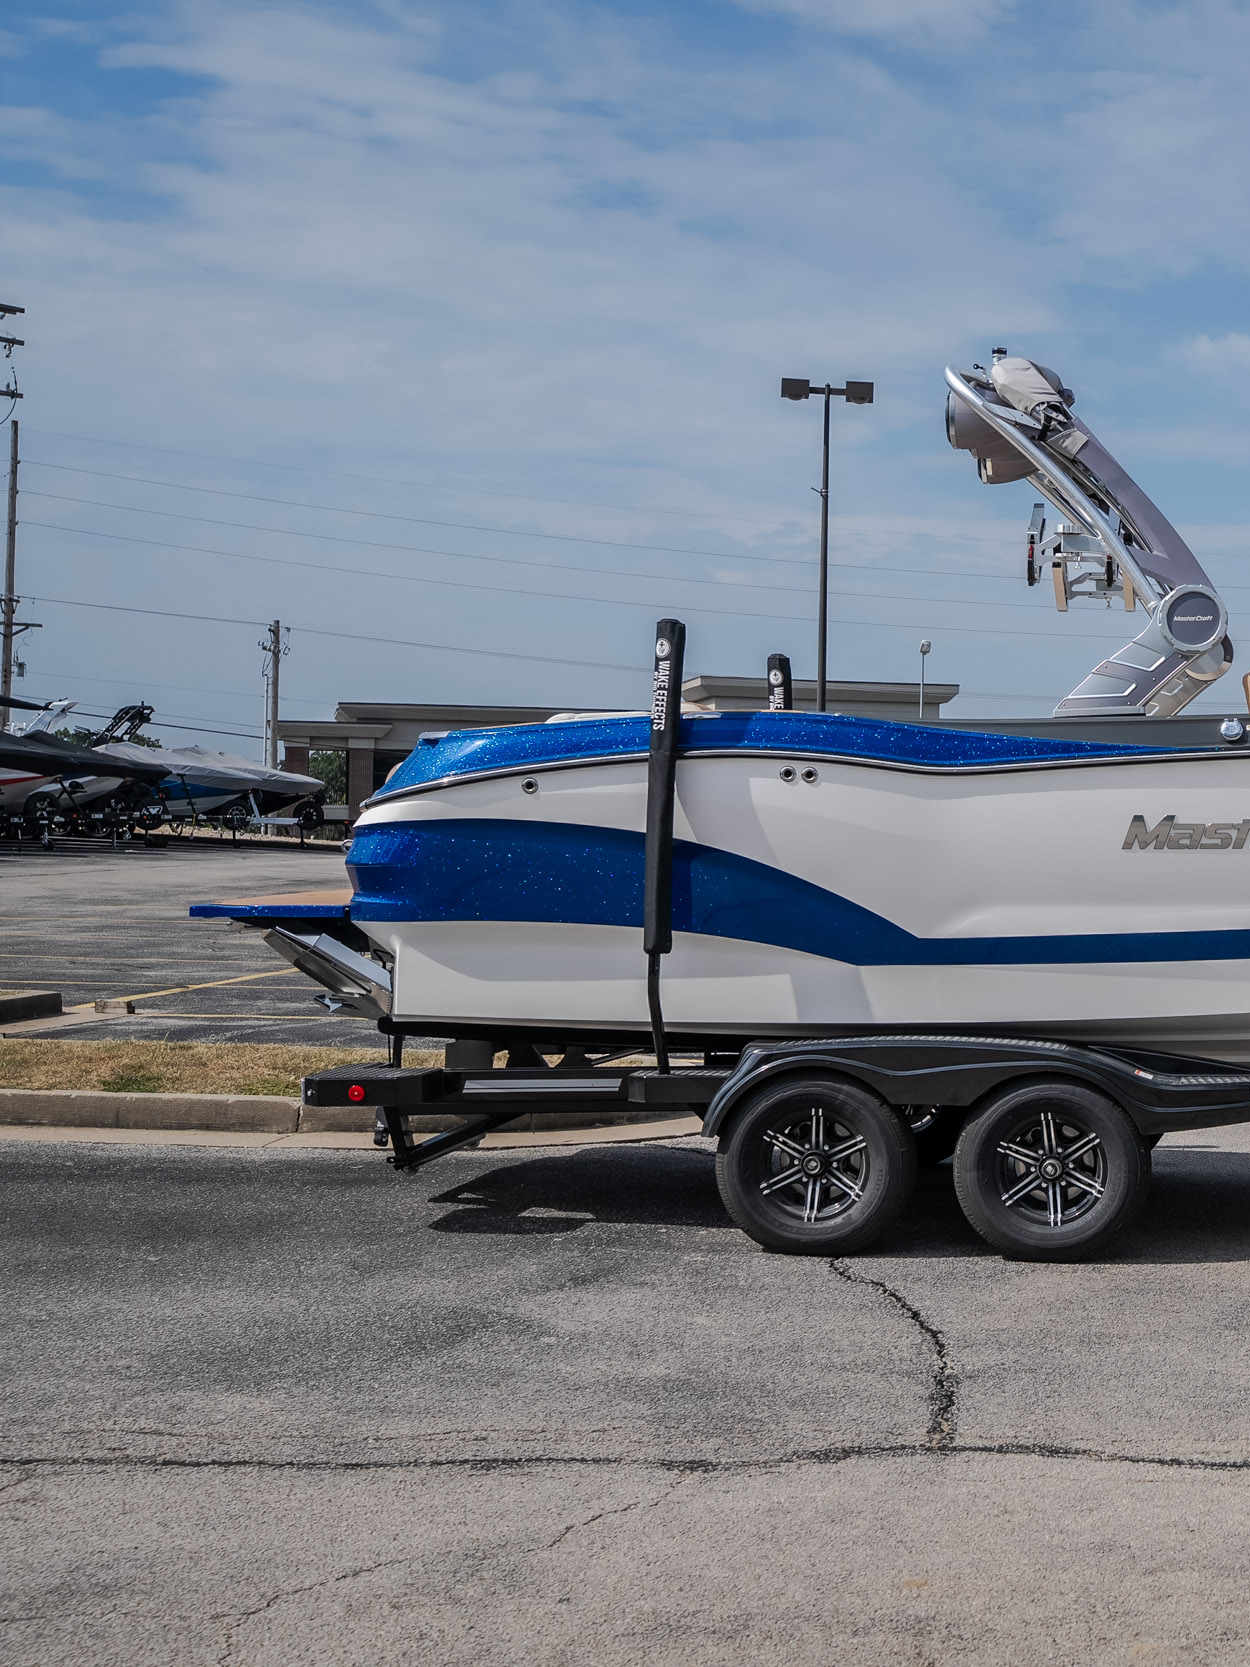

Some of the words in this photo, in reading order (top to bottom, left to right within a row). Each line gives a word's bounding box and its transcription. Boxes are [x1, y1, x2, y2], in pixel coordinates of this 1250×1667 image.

[657, 660, 670, 689] WAKE
[652, 690, 668, 731] EFFECTS
[773, 686, 784, 709] WAKE
